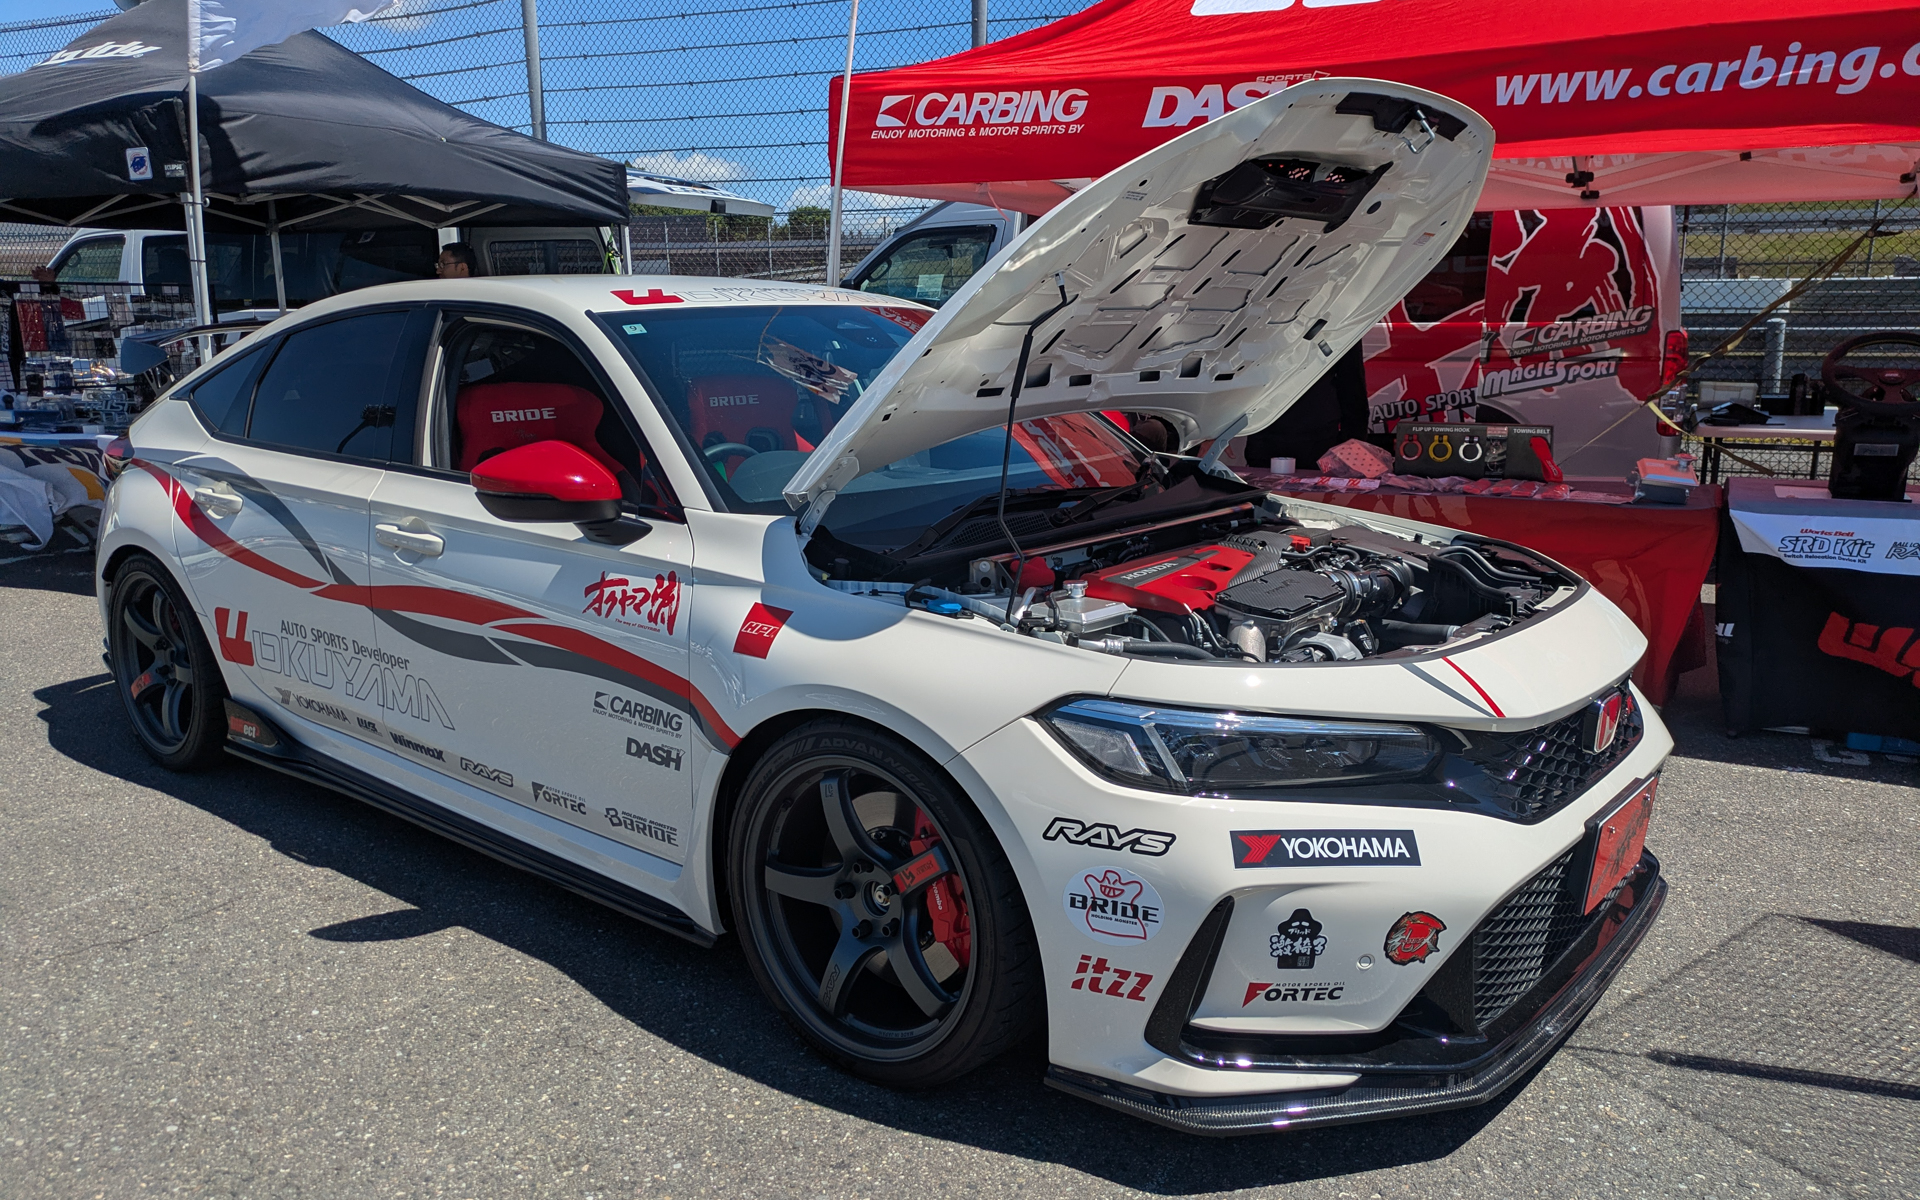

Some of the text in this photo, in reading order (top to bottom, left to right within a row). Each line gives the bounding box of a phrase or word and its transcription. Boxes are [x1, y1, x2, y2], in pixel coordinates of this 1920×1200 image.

[1256, 73, 1312, 83] SPORTS
[915, 88, 1089, 126] CARBING
[1141, 81, 1288, 128] DAS
[871, 124, 1085, 139] ENJOY MOTORING & MOTOR SPIRITS BY
[1533, 340, 1572, 352] MOTORING
[1579, 334, 1604, 345] MOTOR
[1605, 328, 1635, 340] SPIRITS
[1636, 325, 1648, 334] BY
[1538, 306, 1653, 342] CARBING
[709, 394, 759, 407] BRIDE
[1371, 400, 1418, 421] AUTO
[491, 408, 557, 423] BRIDE
[1778, 536, 1875, 558] SRD Kit
[1121, 562, 1178, 580] HONDA
[281, 620, 410, 670] AUTO SPORTS Developer
[252, 630, 455, 730] OKUYAMA
[292, 694, 351, 724] YOKOHAMA
[592, 708, 608, 716] ENJOY
[608, 713, 632, 724] MOTORING
[638, 721, 655, 731] MOTOR
[656, 727, 674, 737] SPIRITS
[610, 696, 683, 731] CARBING
[626, 736, 683, 771] DASH
[819, 738, 884, 759] ADVAN
[460, 757, 514, 787] RAYS
[884, 756, 938, 803] NEOVA
[531, 781, 587, 815] FORTEC
[545, 786, 561, 795] MOTOR
[561, 790, 578, 799] SPORTS
[622, 810, 678, 833] HOLDING MONSTER
[1043, 817, 1176, 856] RAYS
[1281, 837, 1410, 858] YOKOHAMA
[1069, 892, 1159, 923] BRIDE
[1114, 918, 1137, 926] MONSTER
[1071, 954, 1154, 1002] itzz
[1242, 982, 1344, 1008] FORTEC
